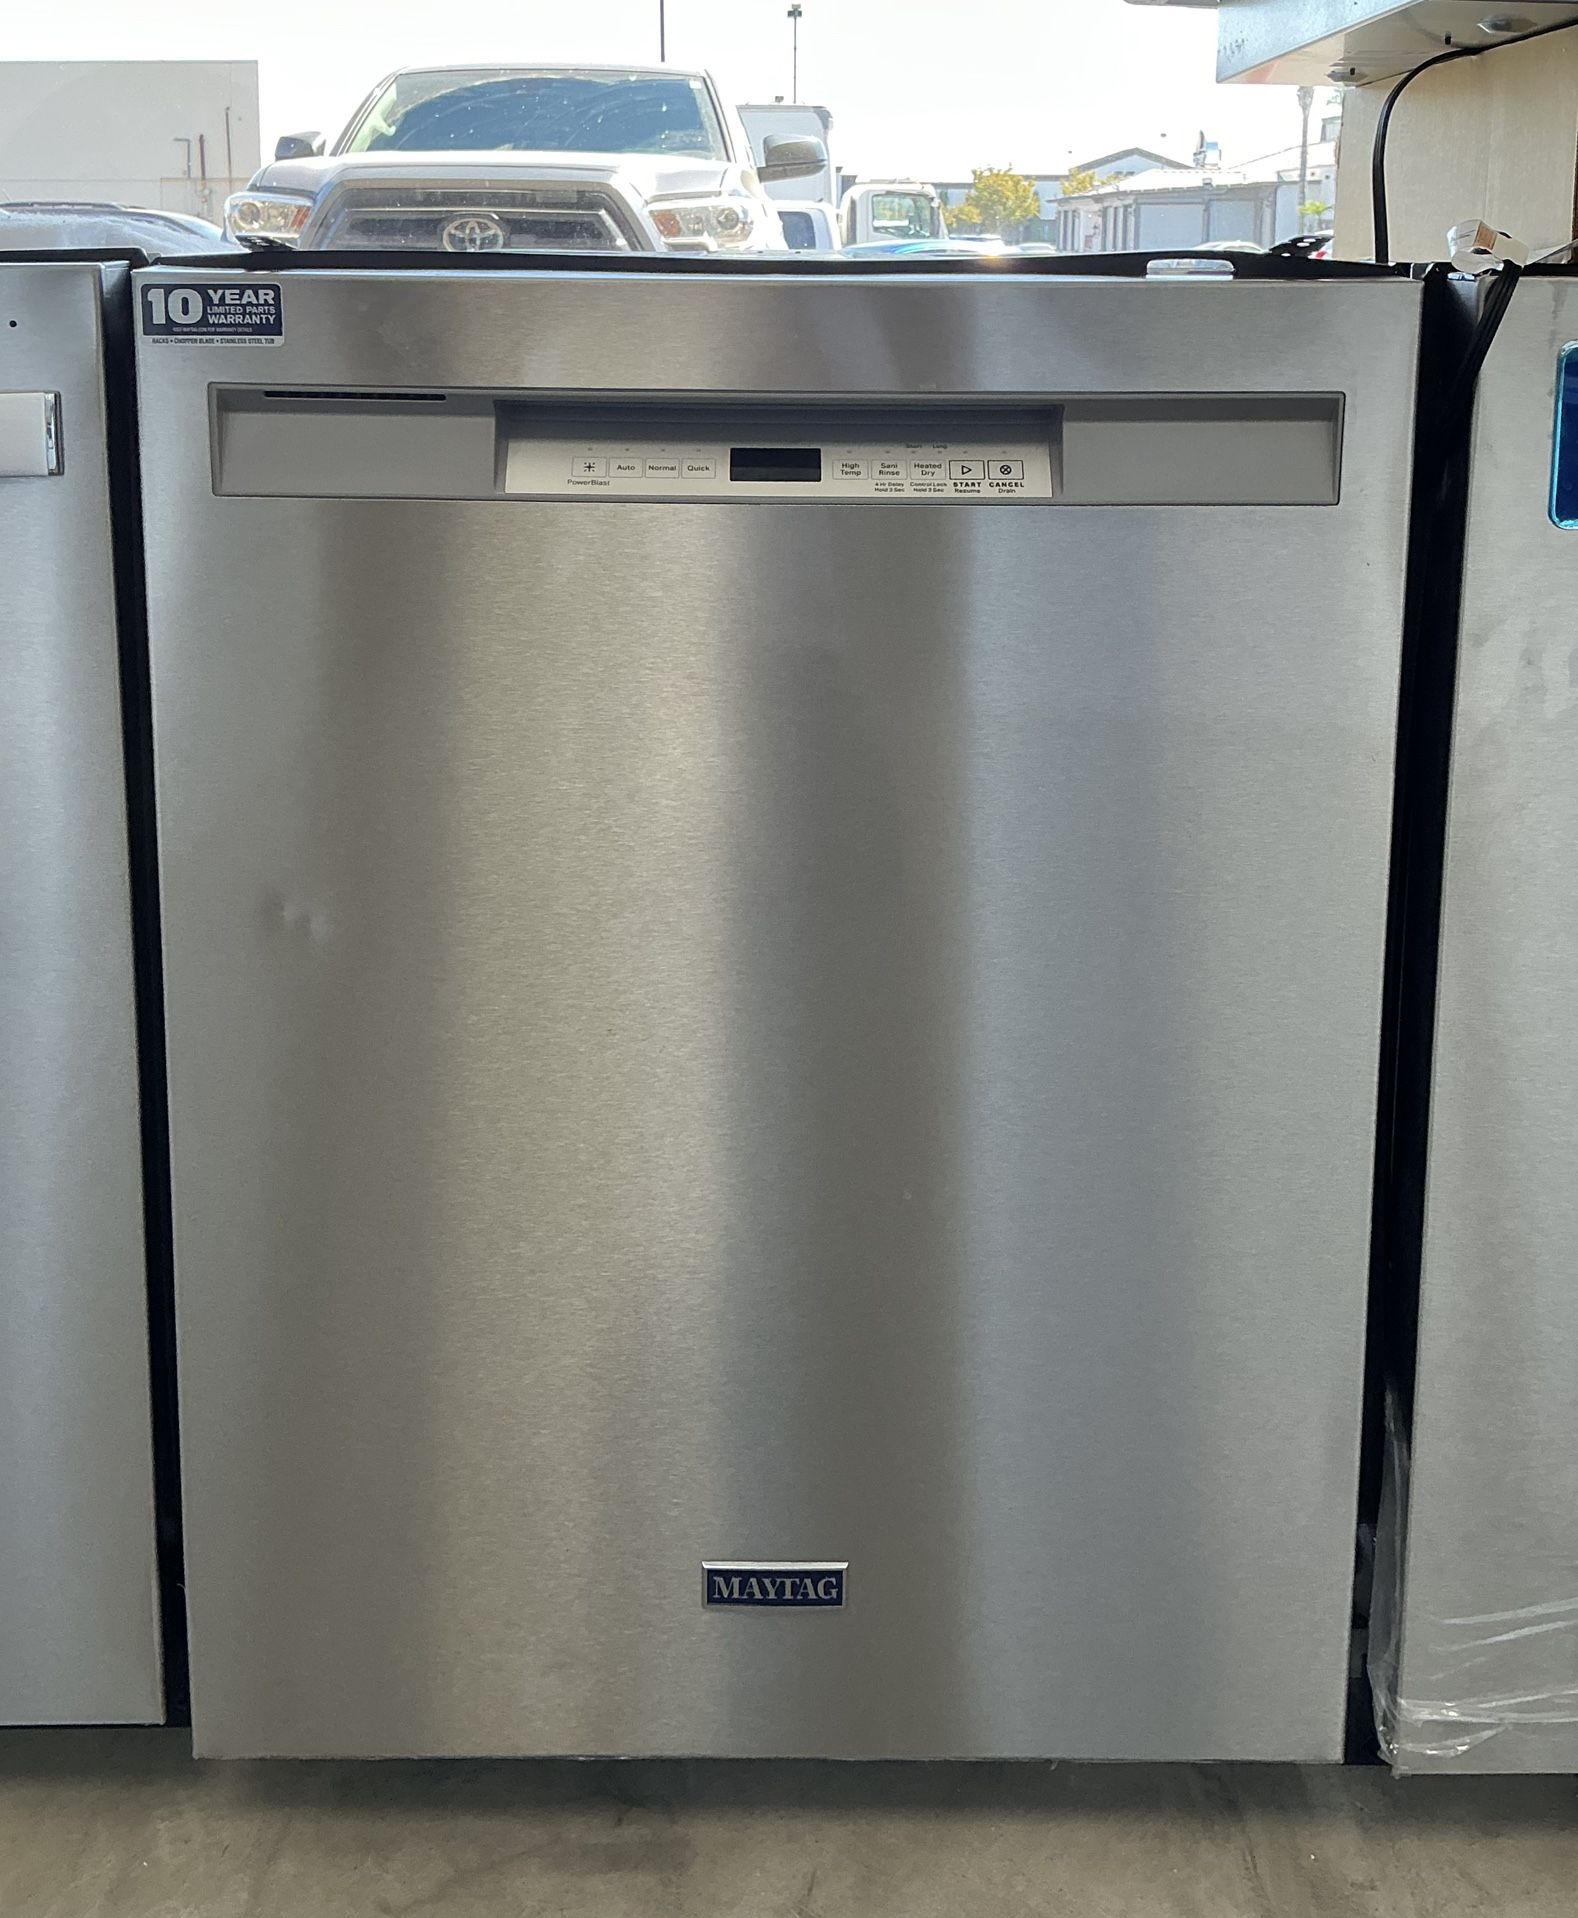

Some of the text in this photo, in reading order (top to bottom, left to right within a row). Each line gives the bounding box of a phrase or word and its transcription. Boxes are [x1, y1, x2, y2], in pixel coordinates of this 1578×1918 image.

[207, 289, 275, 304] YEAR
[147, 288, 203, 325] 10
[207, 306, 276, 314] LIMITED PARTS
[207, 314, 276, 324] WARRANTY
[841, 462, 860, 470] High
[840, 469, 862, 477] Temp
[712, 1576, 839, 1600] MAYTAG
